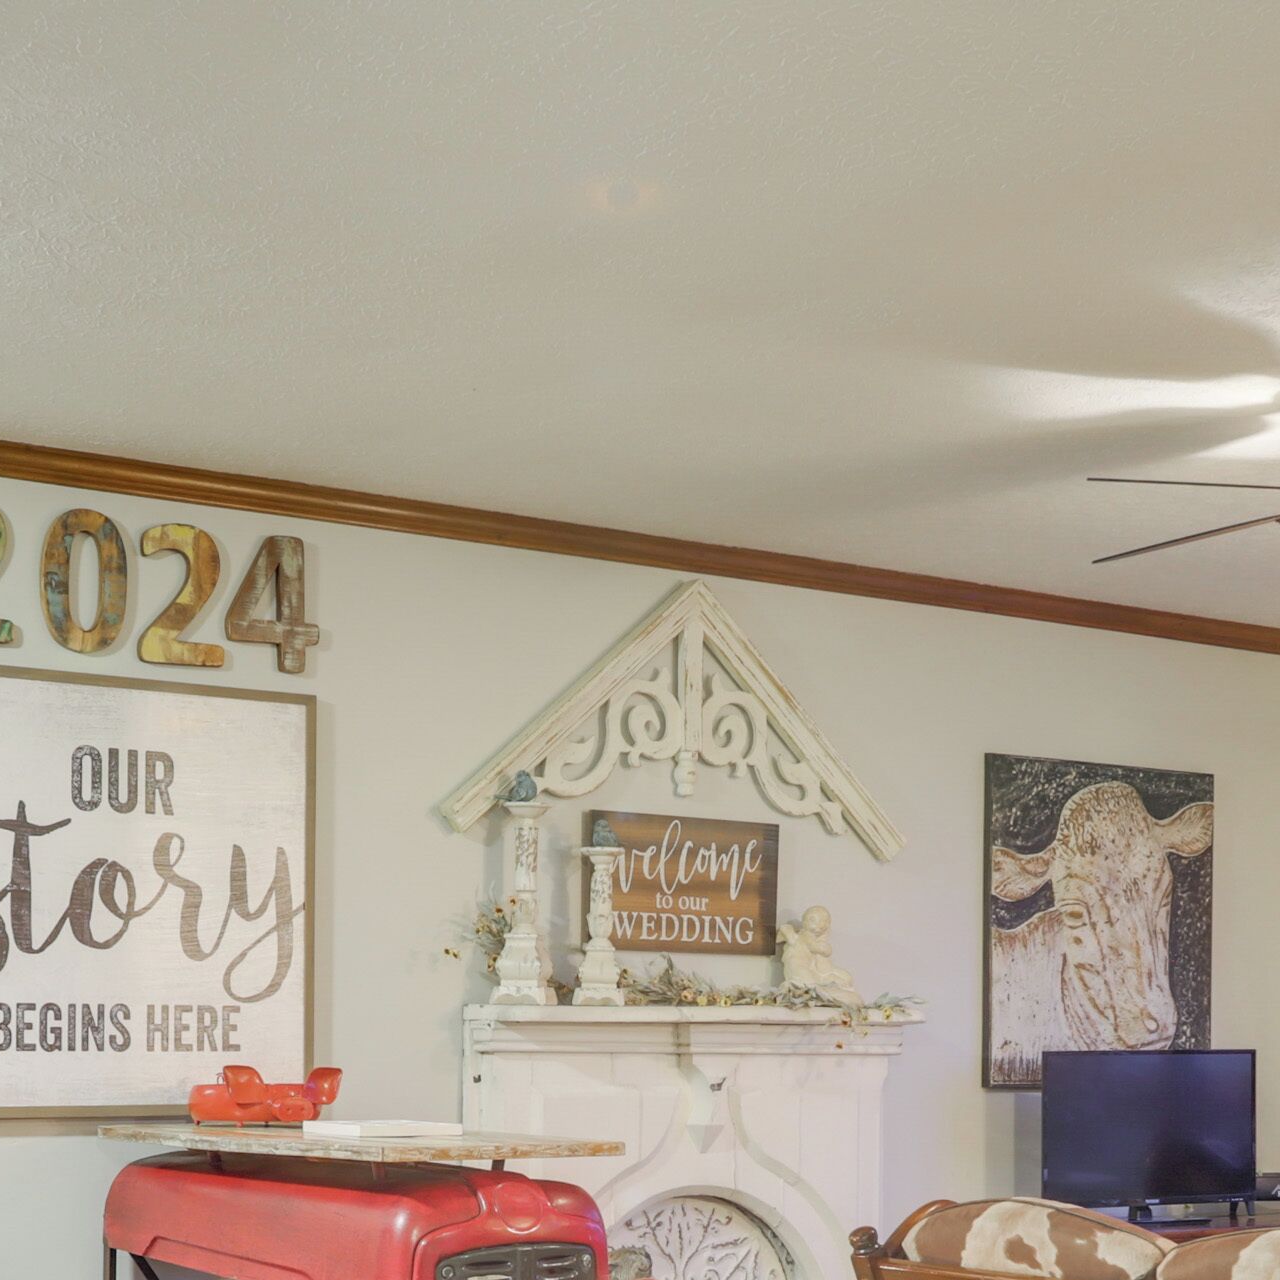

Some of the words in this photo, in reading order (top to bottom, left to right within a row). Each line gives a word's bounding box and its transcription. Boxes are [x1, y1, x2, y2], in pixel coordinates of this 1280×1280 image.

[71, 744, 175, 816] OUR
[656, 891, 674, 910] to
[679, 895, 709, 911] our
[612, 911, 754, 945] WEDDING
[146, 1004, 241, 1053] HERE
